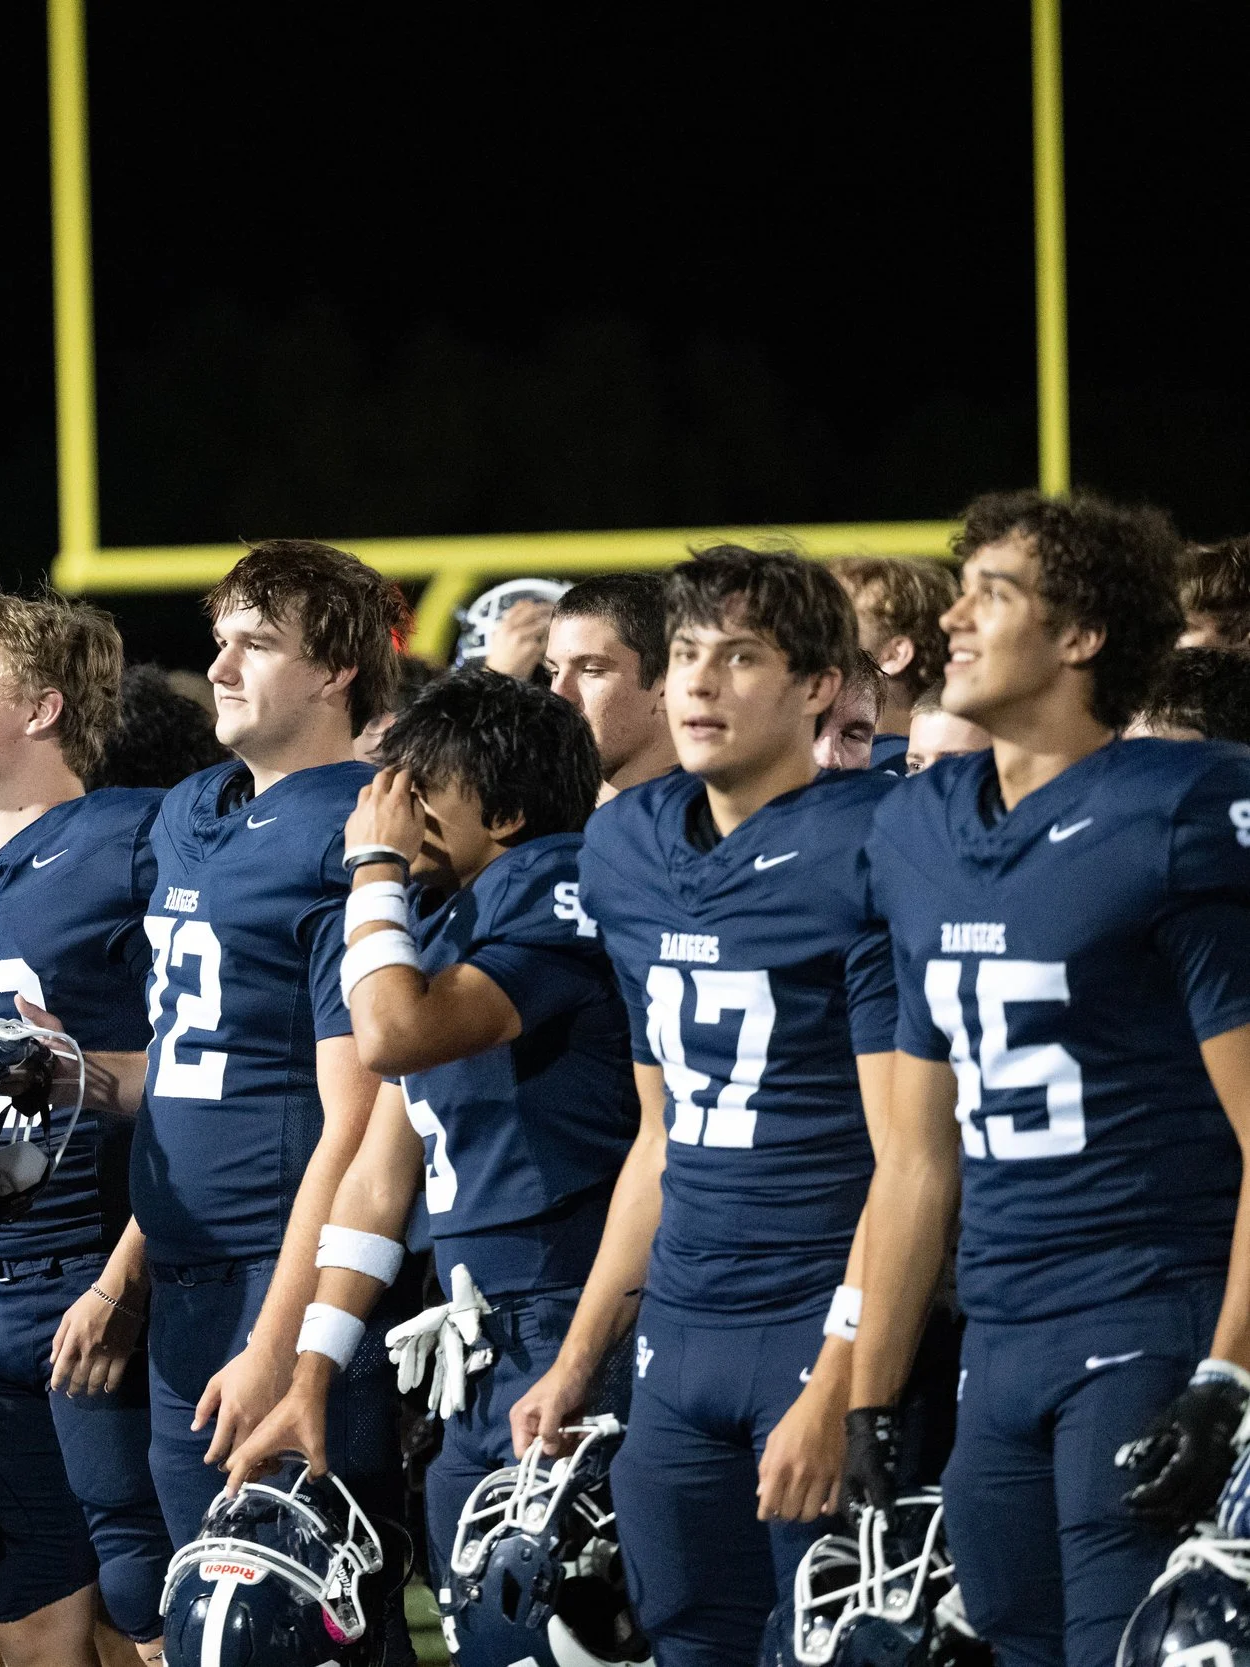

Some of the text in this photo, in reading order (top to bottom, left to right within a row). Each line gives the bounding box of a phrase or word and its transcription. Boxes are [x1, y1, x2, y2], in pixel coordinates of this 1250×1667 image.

[659, 932, 720, 964] RANGERS
[143, 915, 228, 1101] 72
[205, 1563, 255, 1581] Riddell
